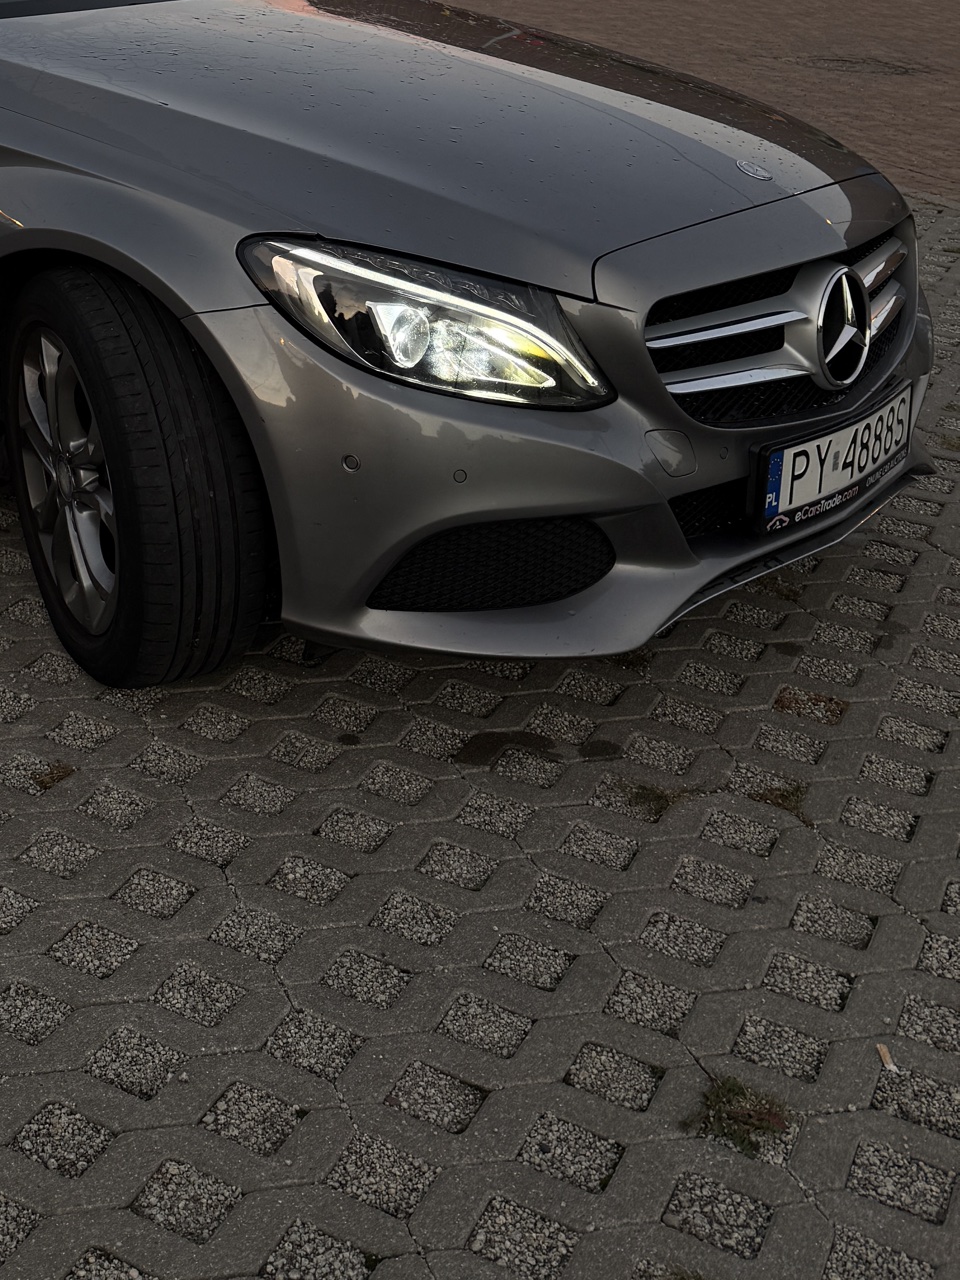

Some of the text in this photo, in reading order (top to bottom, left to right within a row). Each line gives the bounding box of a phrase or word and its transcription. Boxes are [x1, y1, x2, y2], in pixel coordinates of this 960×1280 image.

[788, 397, 906, 506] PY 4888S
[765, 493, 778, 509] PL
[795, 485, 859, 522] eCarsTrade.com
